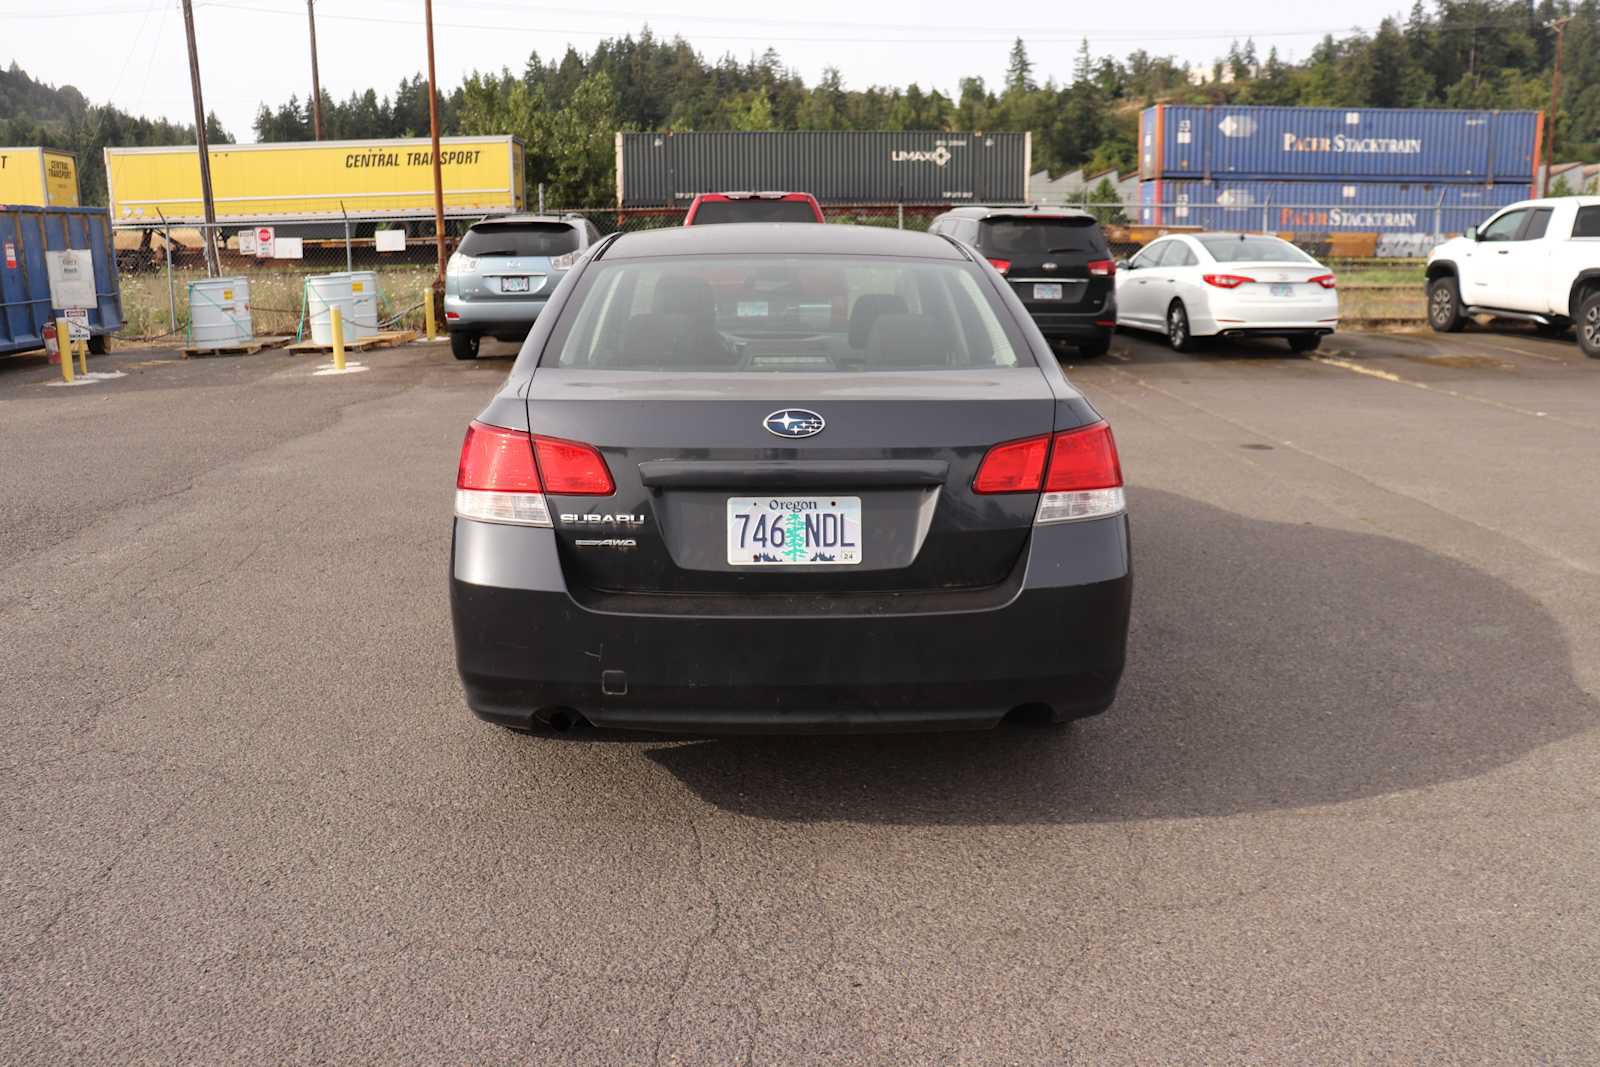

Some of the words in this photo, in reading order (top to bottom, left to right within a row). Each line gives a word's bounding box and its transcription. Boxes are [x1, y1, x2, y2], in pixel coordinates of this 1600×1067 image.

[1283, 132, 1331, 151] PACER
[1333, 134, 1422, 153] STACKTRAIN
[346, 153, 400, 168] CENTRAL
[1329, 208, 1417, 227] STACKTRAIN
[769, 499, 817, 513] Oregon
[560, 513, 645, 525] SUBARU
[735, 513, 785, 548] 746
[805, 513, 855, 548] NDL
